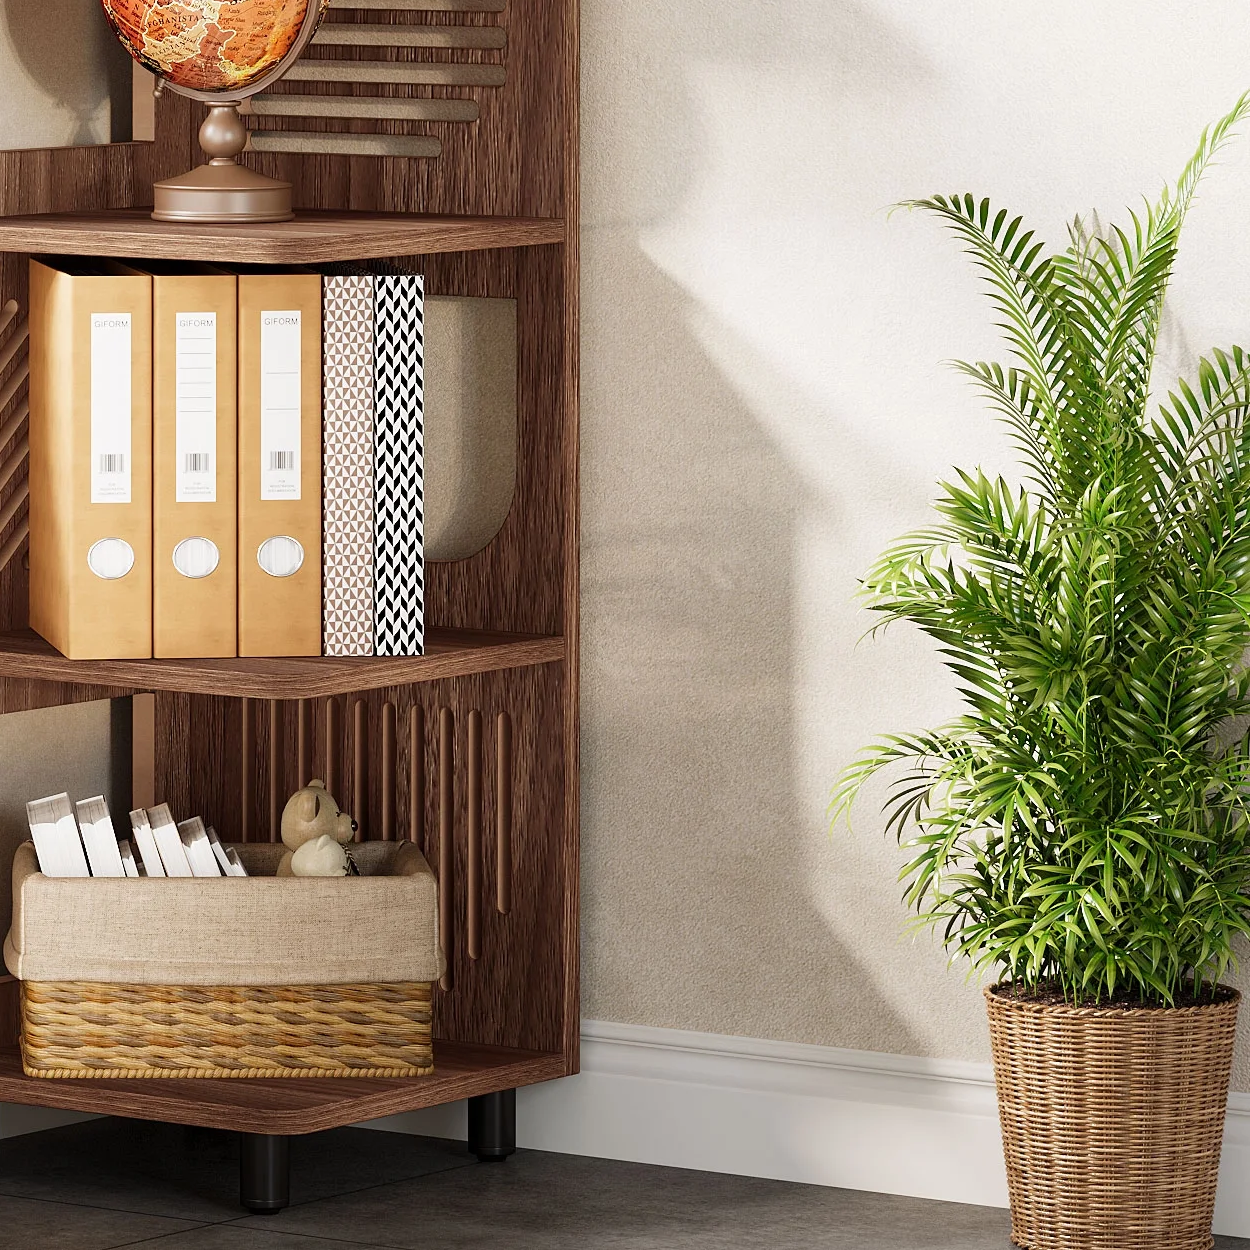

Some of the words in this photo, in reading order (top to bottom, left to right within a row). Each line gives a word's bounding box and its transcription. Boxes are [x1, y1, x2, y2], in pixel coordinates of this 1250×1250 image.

[94, 320, 129, 328] GIFORM
[179, 319, 214, 328] GIFORM
[264, 317, 299, 326] GIFORM
